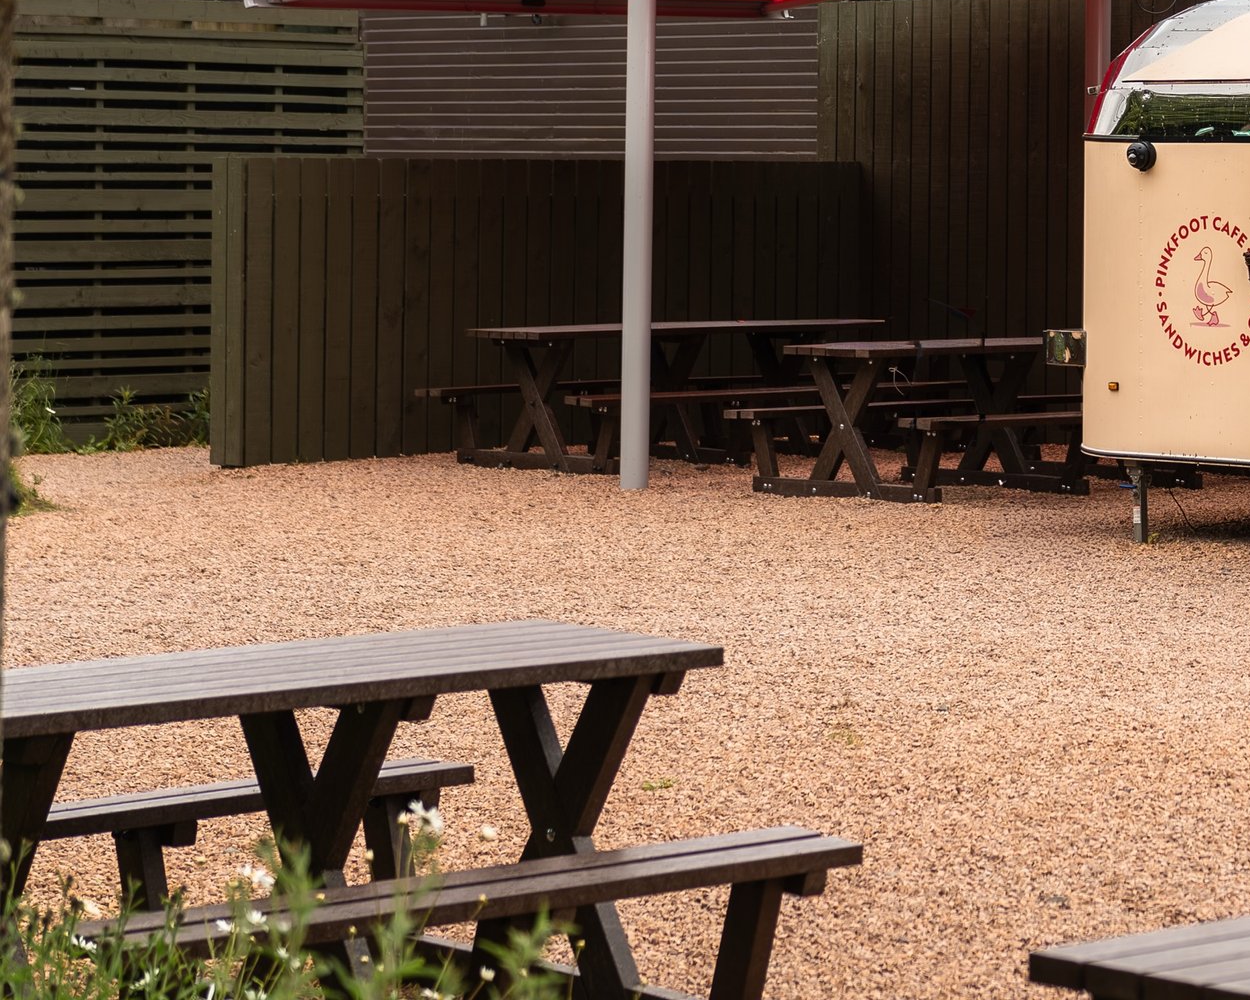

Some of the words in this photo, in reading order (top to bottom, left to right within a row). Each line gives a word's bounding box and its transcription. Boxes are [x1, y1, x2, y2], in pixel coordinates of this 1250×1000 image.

[1155, 215, 1209, 288] PINKFOOT
[1212, 216, 1248, 248] CAFE
[1156, 301, 1241, 367] SANDWICHES
